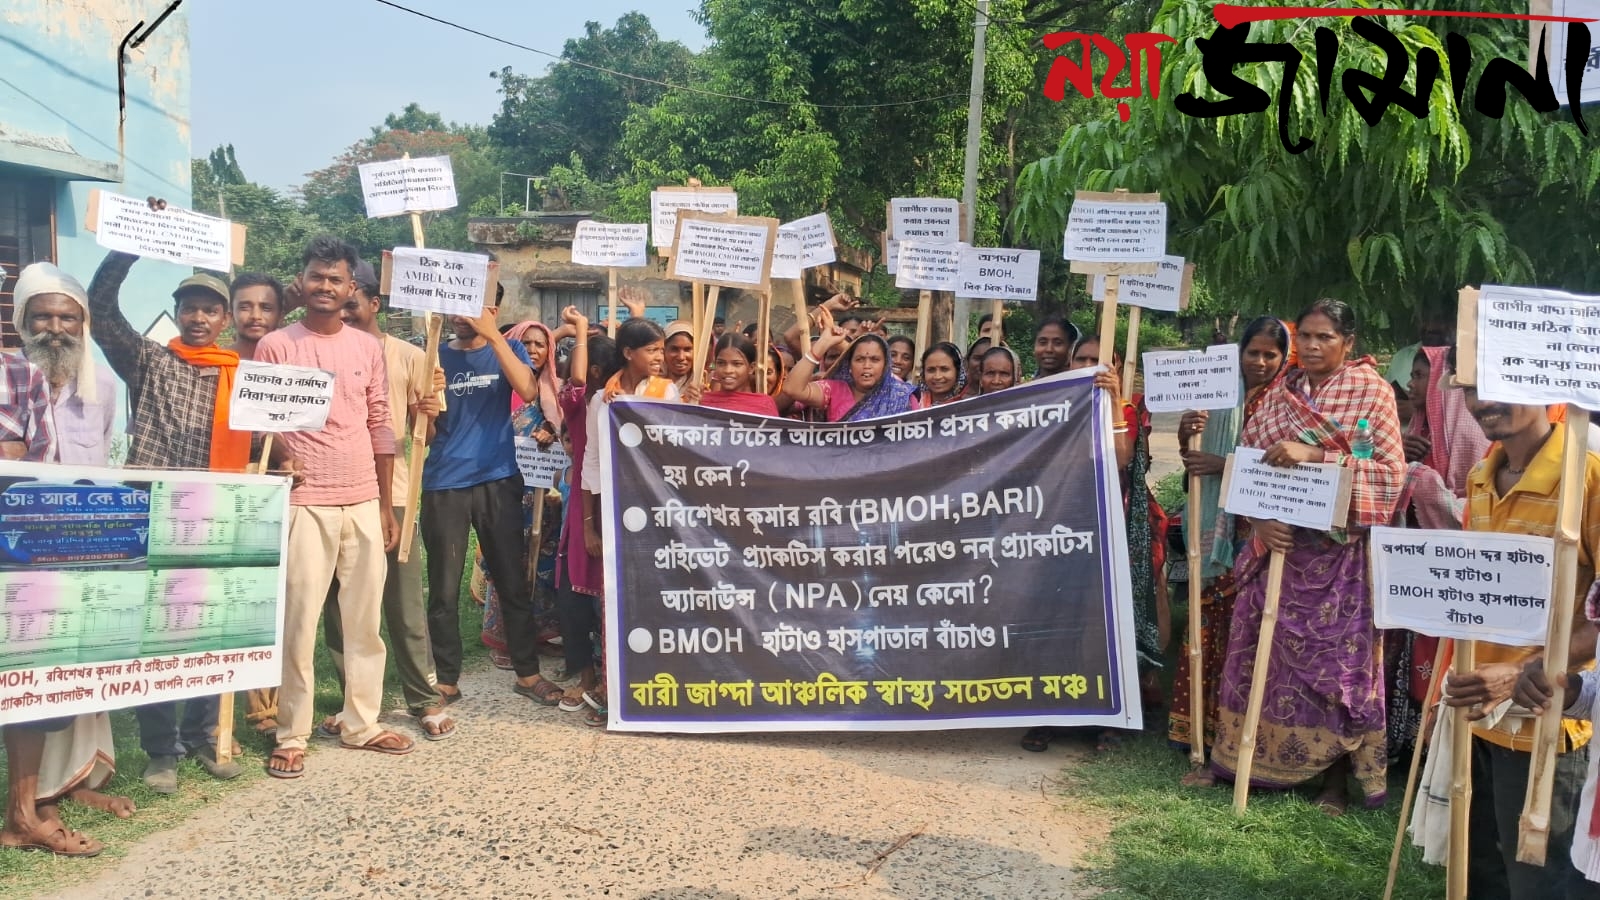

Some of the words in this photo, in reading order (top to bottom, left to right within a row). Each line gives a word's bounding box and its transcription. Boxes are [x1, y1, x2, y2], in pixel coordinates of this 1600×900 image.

[420, 256, 440, 267] ঠিক
[978, 253, 1022, 263] অপদার্থ
[405, 271, 477, 288] AMBULANCE
[1492, 300, 1532, 313] রোগীর
[1488, 319, 1526, 330] খাবার
[1531, 320, 1572, 332] সঠিক
[1156, 358, 1185, 366] Labour
[1500, 374, 1550, 386] আপনি
[644, 422, 724, 446] অন্ধকার
[729, 418, 783, 448] টর্চের
[787, 424, 876, 448] আলোতে
[881, 417, 934, 442] বাচ্চা
[940, 412, 990, 437] প্রসব
[994, 400, 1072, 430] করানো
[662, 465, 687, 489] হয়
[1, 492, 34, 506] ডাঃ
[120, 490, 150, 506] রবি
[651, 500, 740, 528] রবিশেখর
[743, 504, 800, 536] কুমার
[805, 497, 842, 527] রবি
[654, 540, 731, 572] প্রাইভেট
[743, 540, 826, 569] প্র্যাকটিস
[830, 544, 887, 568] করার
[894, 540, 957, 564] পরেও
[1000, 524, 1094, 560] প্র্যাকটিস
[1382, 542, 1427, 556] অপদার্থ
[1435, 546, 1476, 560] BMOH
[1506, 548, 1551, 569] হাটাও,
[660, 581, 756, 614] অ্যালাউন্স
[868, 585, 908, 608] নেয়
[1390, 584, 1433, 598] BMOH
[1438, 587, 1474, 603] হাটাও
[1479, 592, 1546, 609] হাসপাতাল
[1445, 608, 1484, 625] বাঁচাও
[658, 628, 743, 653] BMOH
[762, 622, 820, 657] হাটাও
[827, 625, 928, 656] হাসপাতাল
[45, 666, 92, 682] রবিশেখর
[96, 665, 122, 680] কুমার
[125, 660, 142, 674] রবি
[144, 656, 180, 672] প্রাইভেট
[183, 652, 220, 669] প্র্যাকটিস
[222, 653, 245, 664] করার
[248, 650, 272, 662] পরেও
[102, 679, 149, 700] (NPA)
[154, 676, 182, 690] আপনি
[186, 676, 202, 688] নেন
[206, 674, 224, 686] কেন
[629, 672, 679, 707] বারী
[760, 672, 868, 706] আঞ্চলিক
[872, 677, 936, 711] স্বাস্থ্য
[940, 676, 1033, 703] সচেতন
